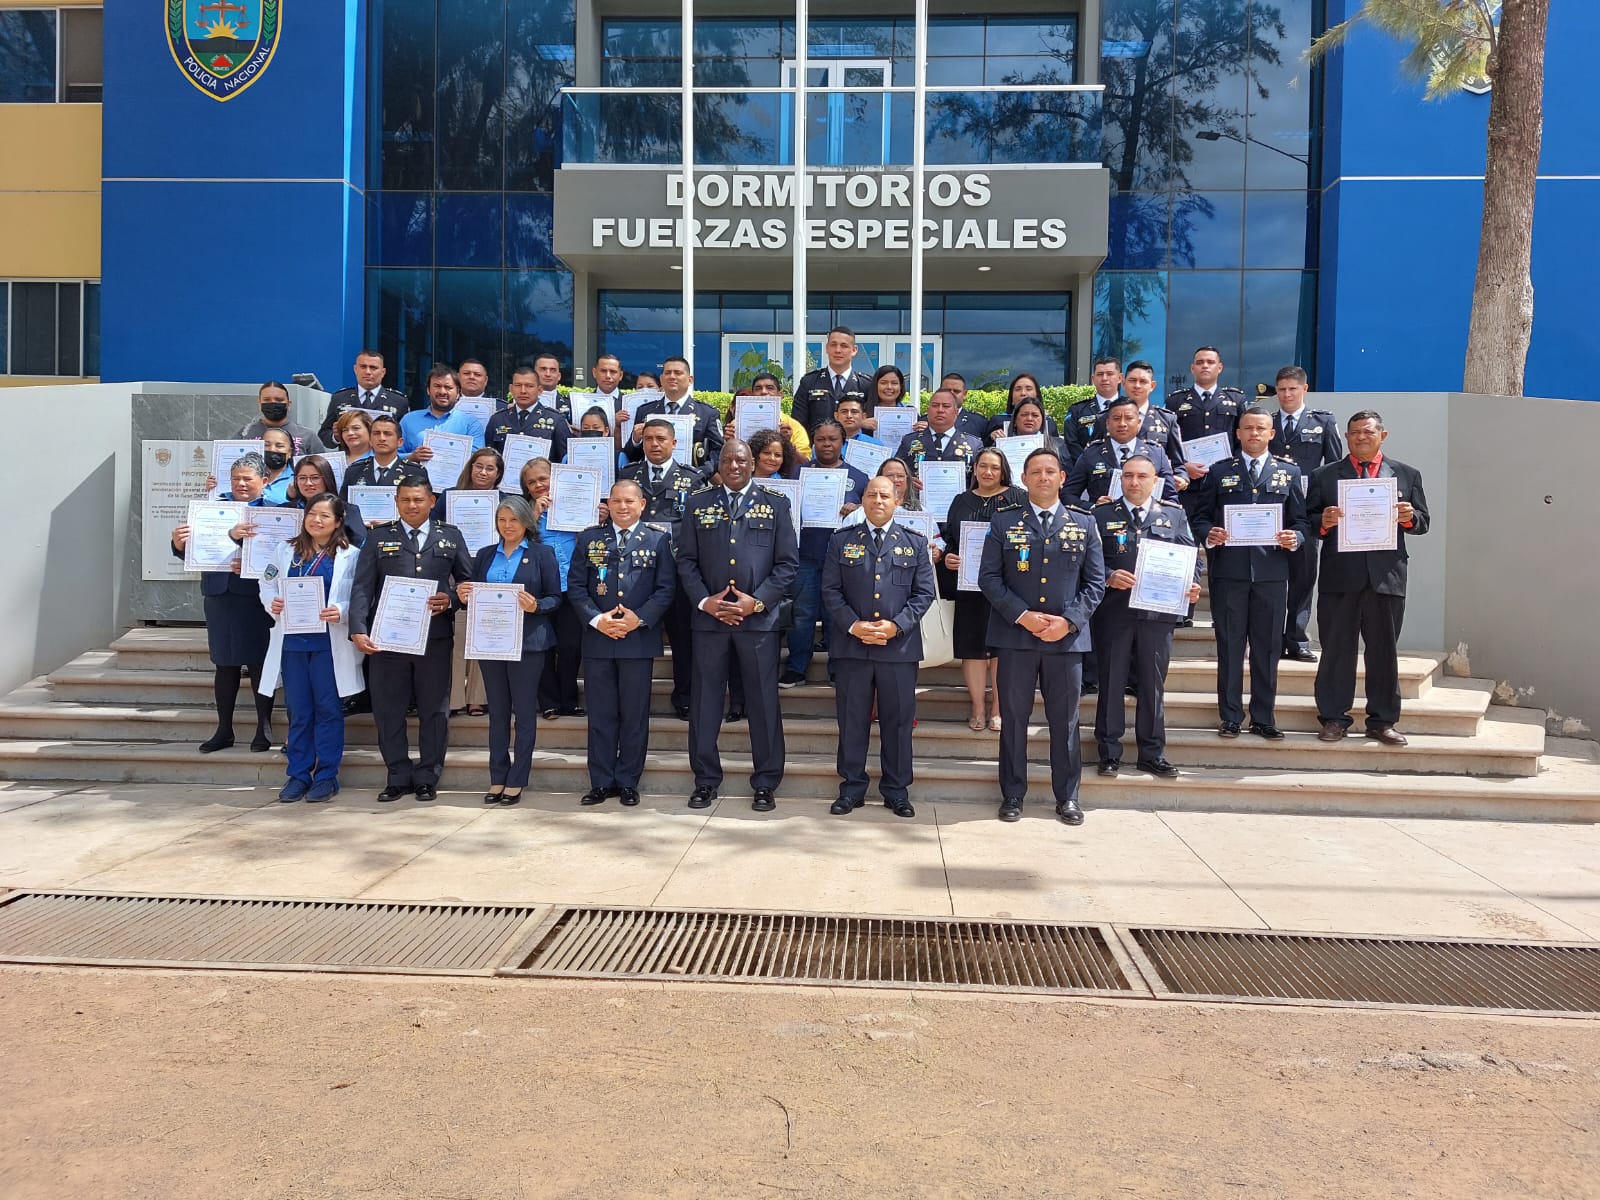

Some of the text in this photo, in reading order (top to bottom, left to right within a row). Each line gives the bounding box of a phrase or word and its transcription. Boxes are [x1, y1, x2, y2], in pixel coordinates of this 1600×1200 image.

[184, 47, 271, 90] POLICIA NACIONAL
[666, 174, 992, 208] DORMITOROS
[592, 218, 1068, 249] FUERZAS ESPECIALES
